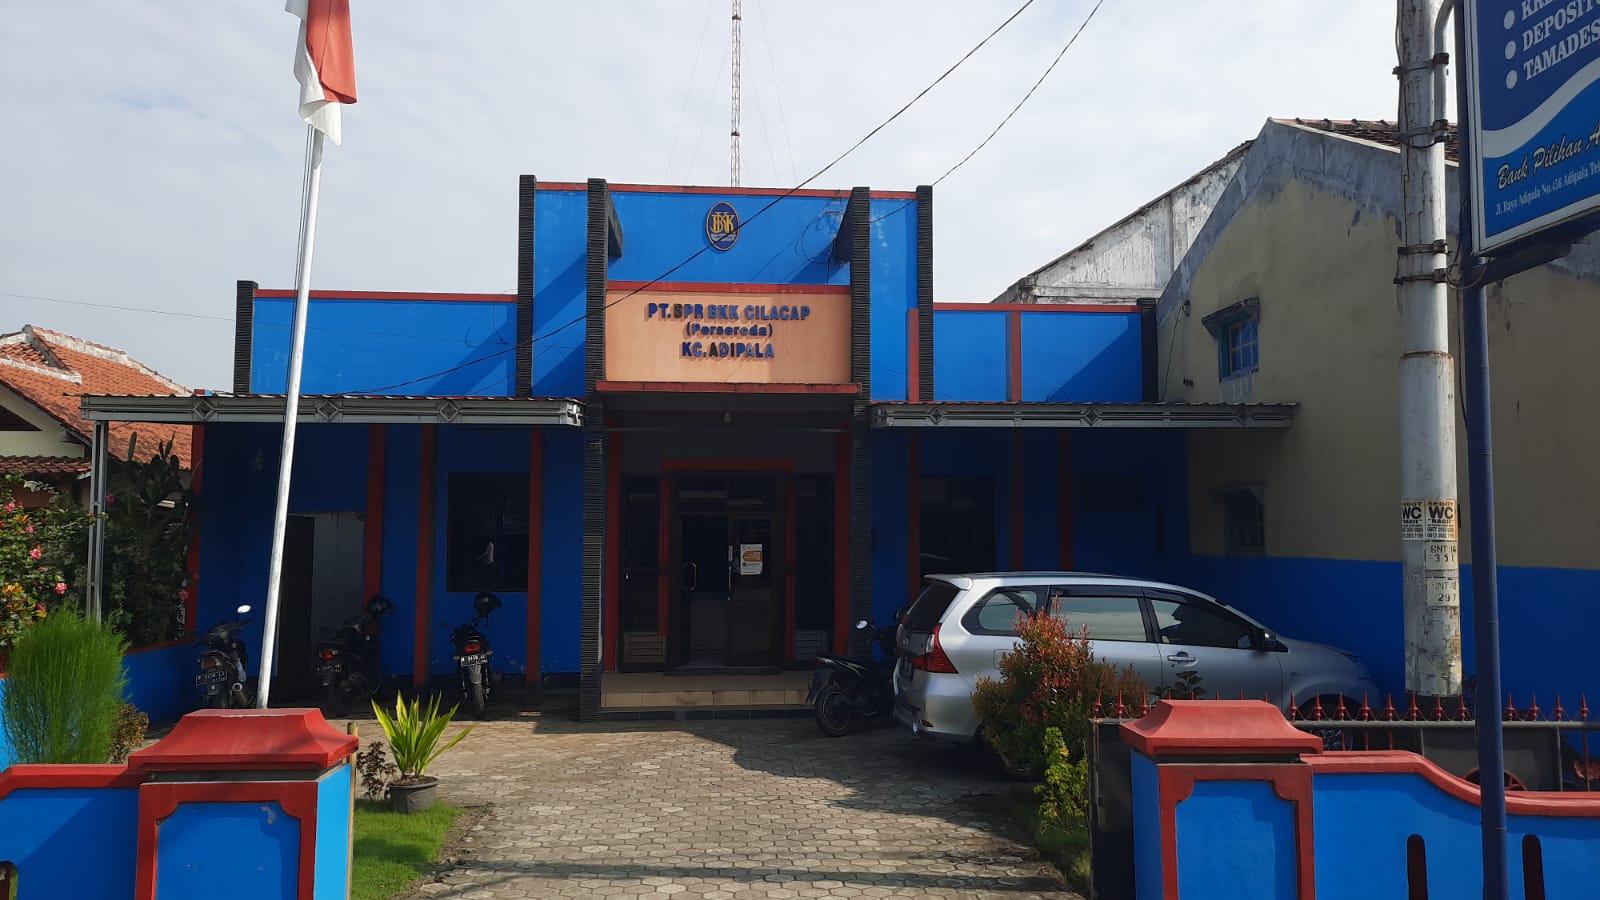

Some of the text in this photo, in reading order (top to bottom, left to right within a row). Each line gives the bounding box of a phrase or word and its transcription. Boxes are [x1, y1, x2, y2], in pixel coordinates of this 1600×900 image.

[1497, 157, 1529, 189] Bank
[1533, 135, 1582, 174] Pilihan
[1563, 166, 1588, 187] Adipala
[708, 305, 739, 320] BKK
[744, 305, 810, 321] CILACAP
[1428, 506, 1453, 519] WC
